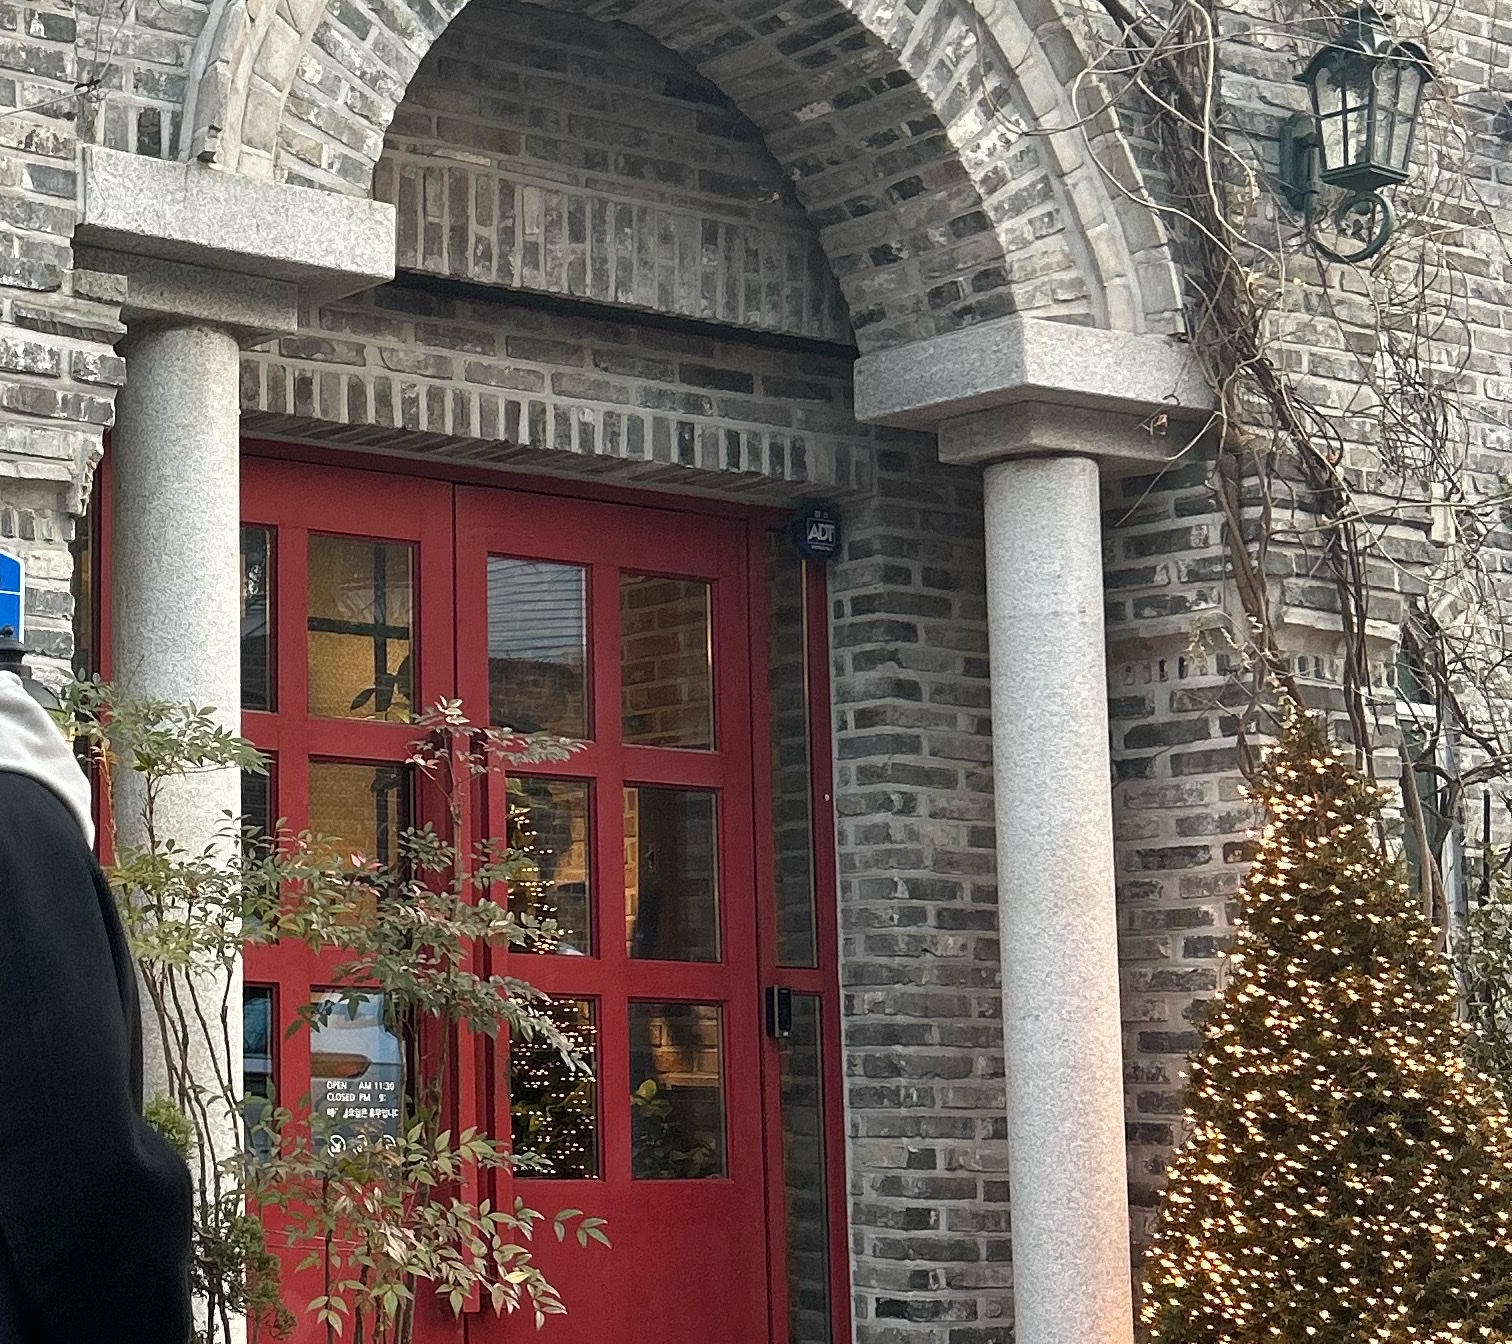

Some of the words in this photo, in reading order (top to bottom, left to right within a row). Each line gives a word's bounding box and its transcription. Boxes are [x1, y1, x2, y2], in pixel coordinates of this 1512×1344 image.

[808, 523, 835, 542] ADT
[326, 1080, 347, 1090] OPEN
[358, 1081, 372, 1090] AM
[326, 1092, 356, 1102] CLOSED
[358, 1093, 371, 1102] PM
[326, 1107, 339, 1118] 매
